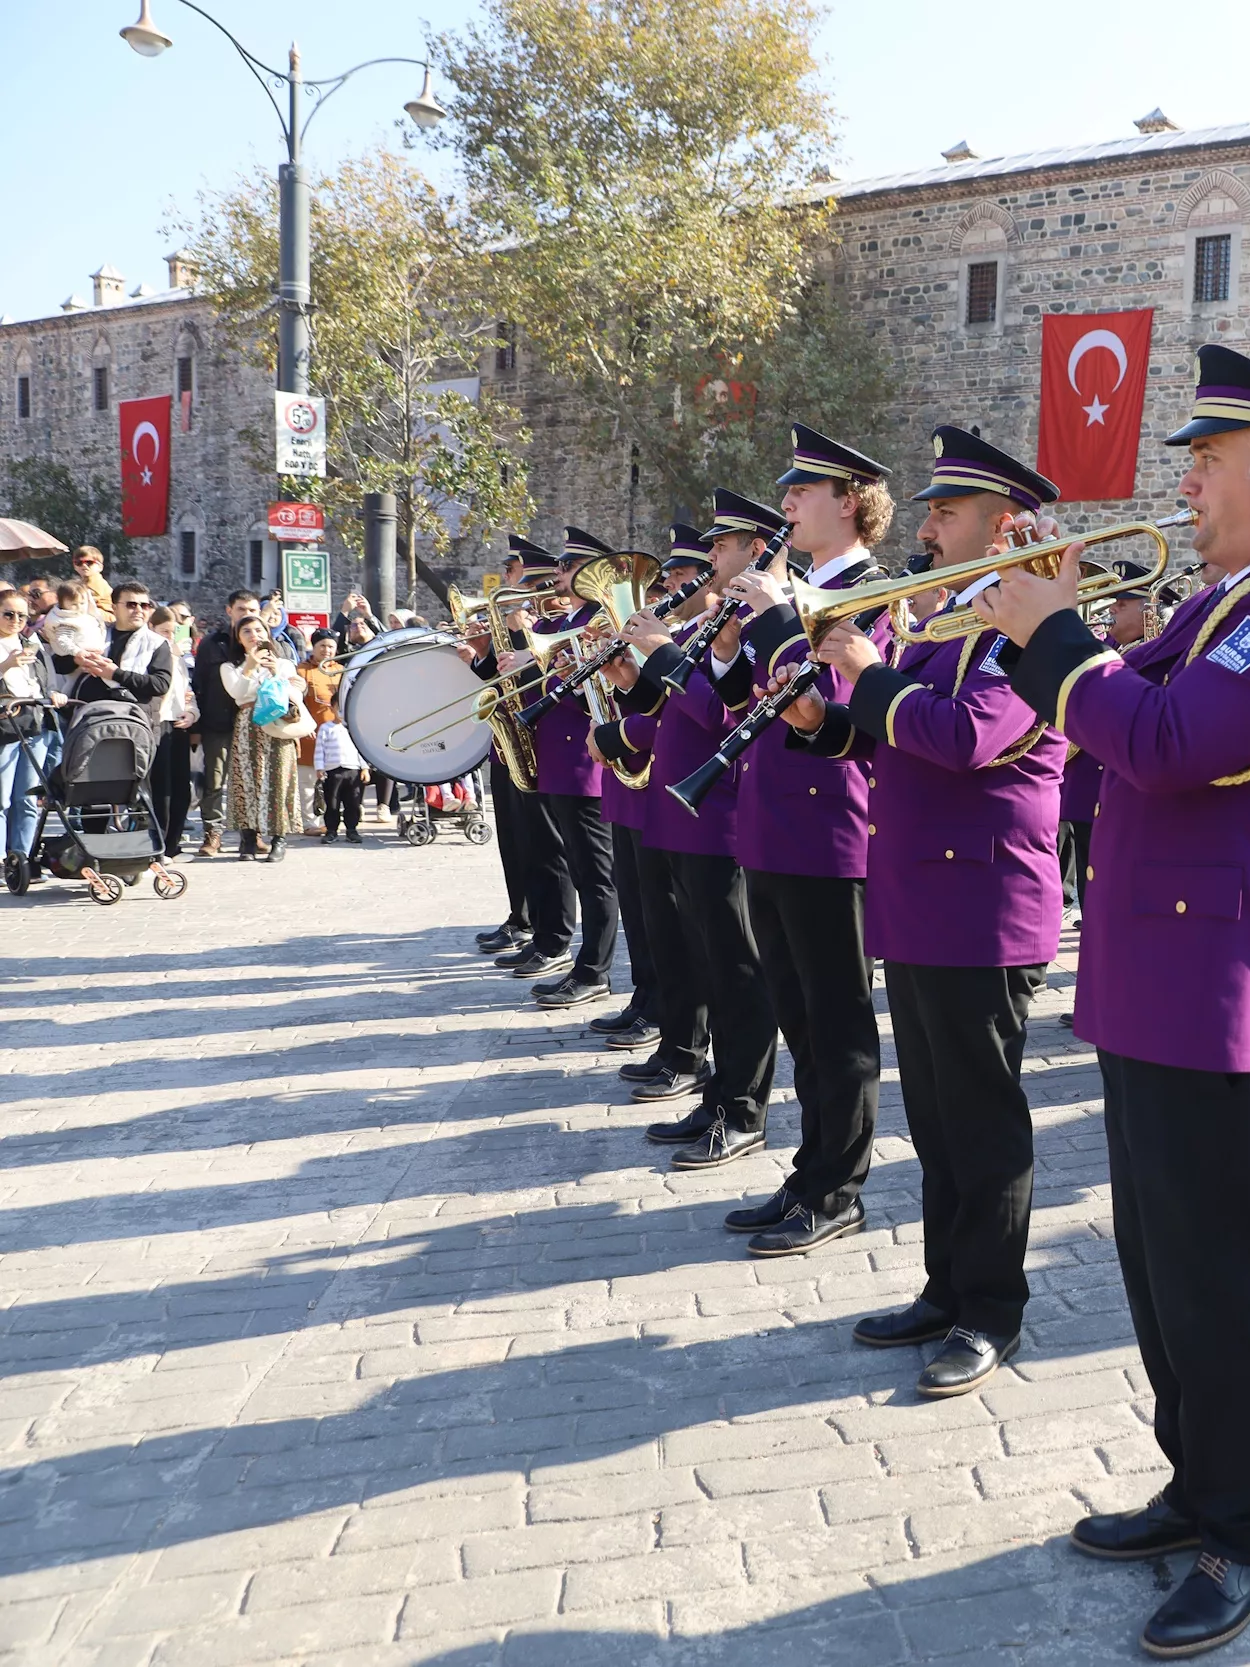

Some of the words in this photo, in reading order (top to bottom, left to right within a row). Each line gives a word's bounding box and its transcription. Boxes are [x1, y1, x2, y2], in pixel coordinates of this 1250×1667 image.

[292, 408, 301, 425] 5
[284, 460, 299, 469] 600
[279, 511, 294, 521] T3
[1219, 643, 1247, 667] BURSA
